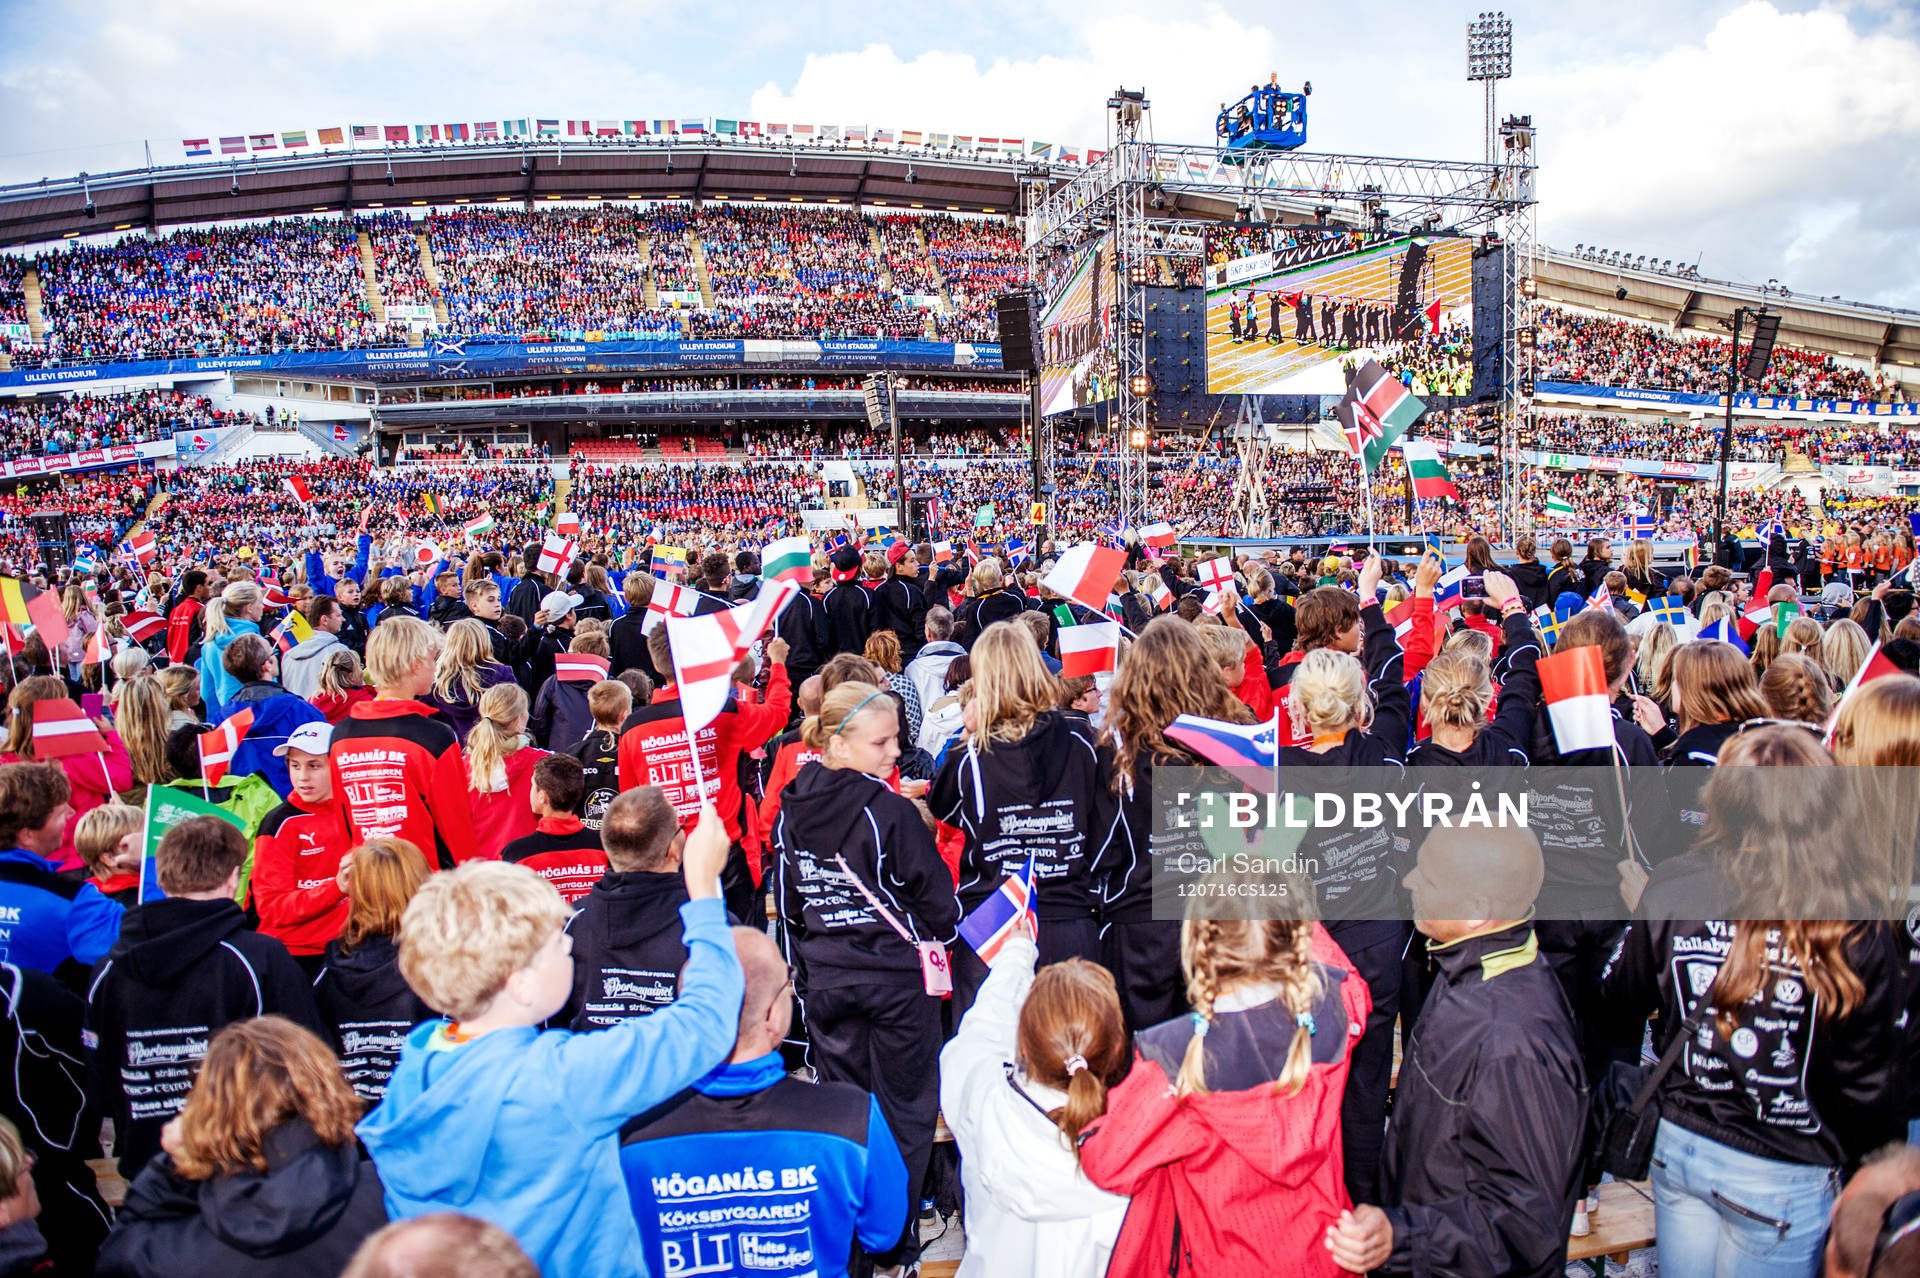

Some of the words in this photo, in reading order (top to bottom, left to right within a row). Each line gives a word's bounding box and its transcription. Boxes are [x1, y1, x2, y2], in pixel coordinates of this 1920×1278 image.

[527, 346, 554, 354] ULLEVI
[847, 342, 878, 350] STADIUM
[366, 353, 393, 361] ULLEVI
[394, 351, 428, 359] STADIUM
[197, 361, 227, 369] ULLEVI
[227, 359, 262, 368] STADIUM
[24, 372, 56, 382] ULLEVI
[57, 369, 98, 380] STADIUM
[1615, 390, 1640, 398] ULLEVI
[1640, 392, 1671, 400] STADIUM
[79, 452, 103, 462] GEVALIA
[112, 448, 135, 458] GEVALIA
[15, 461, 39, 471] GEVALIA
[46, 456, 70, 467] GEVALIA
[1665, 463, 1695, 474] Malaco
[1034, 506, 1043, 522] 4
[641, 730, 697, 750] HÖGANÄ
[700, 727, 716, 739] BK
[337, 749, 387, 766] HÖGANÄS
[388, 751, 407, 762] BK
[649, 763, 680, 785] BIT
[344, 782, 374, 804] BIT
[1024, 847, 1057, 858] CEATOR
[537, 863, 592, 879] HÖGANÄS
[593, 864, 605, 874] BK
[1705, 920, 1727, 937] Vi
[652, 1167, 775, 1198] HÖGANÄS
[781, 1165, 818, 1188] BK
[659, 1200, 811, 1228] KÖKSBYGGAREN
[661, 1231, 732, 1274] BIT
